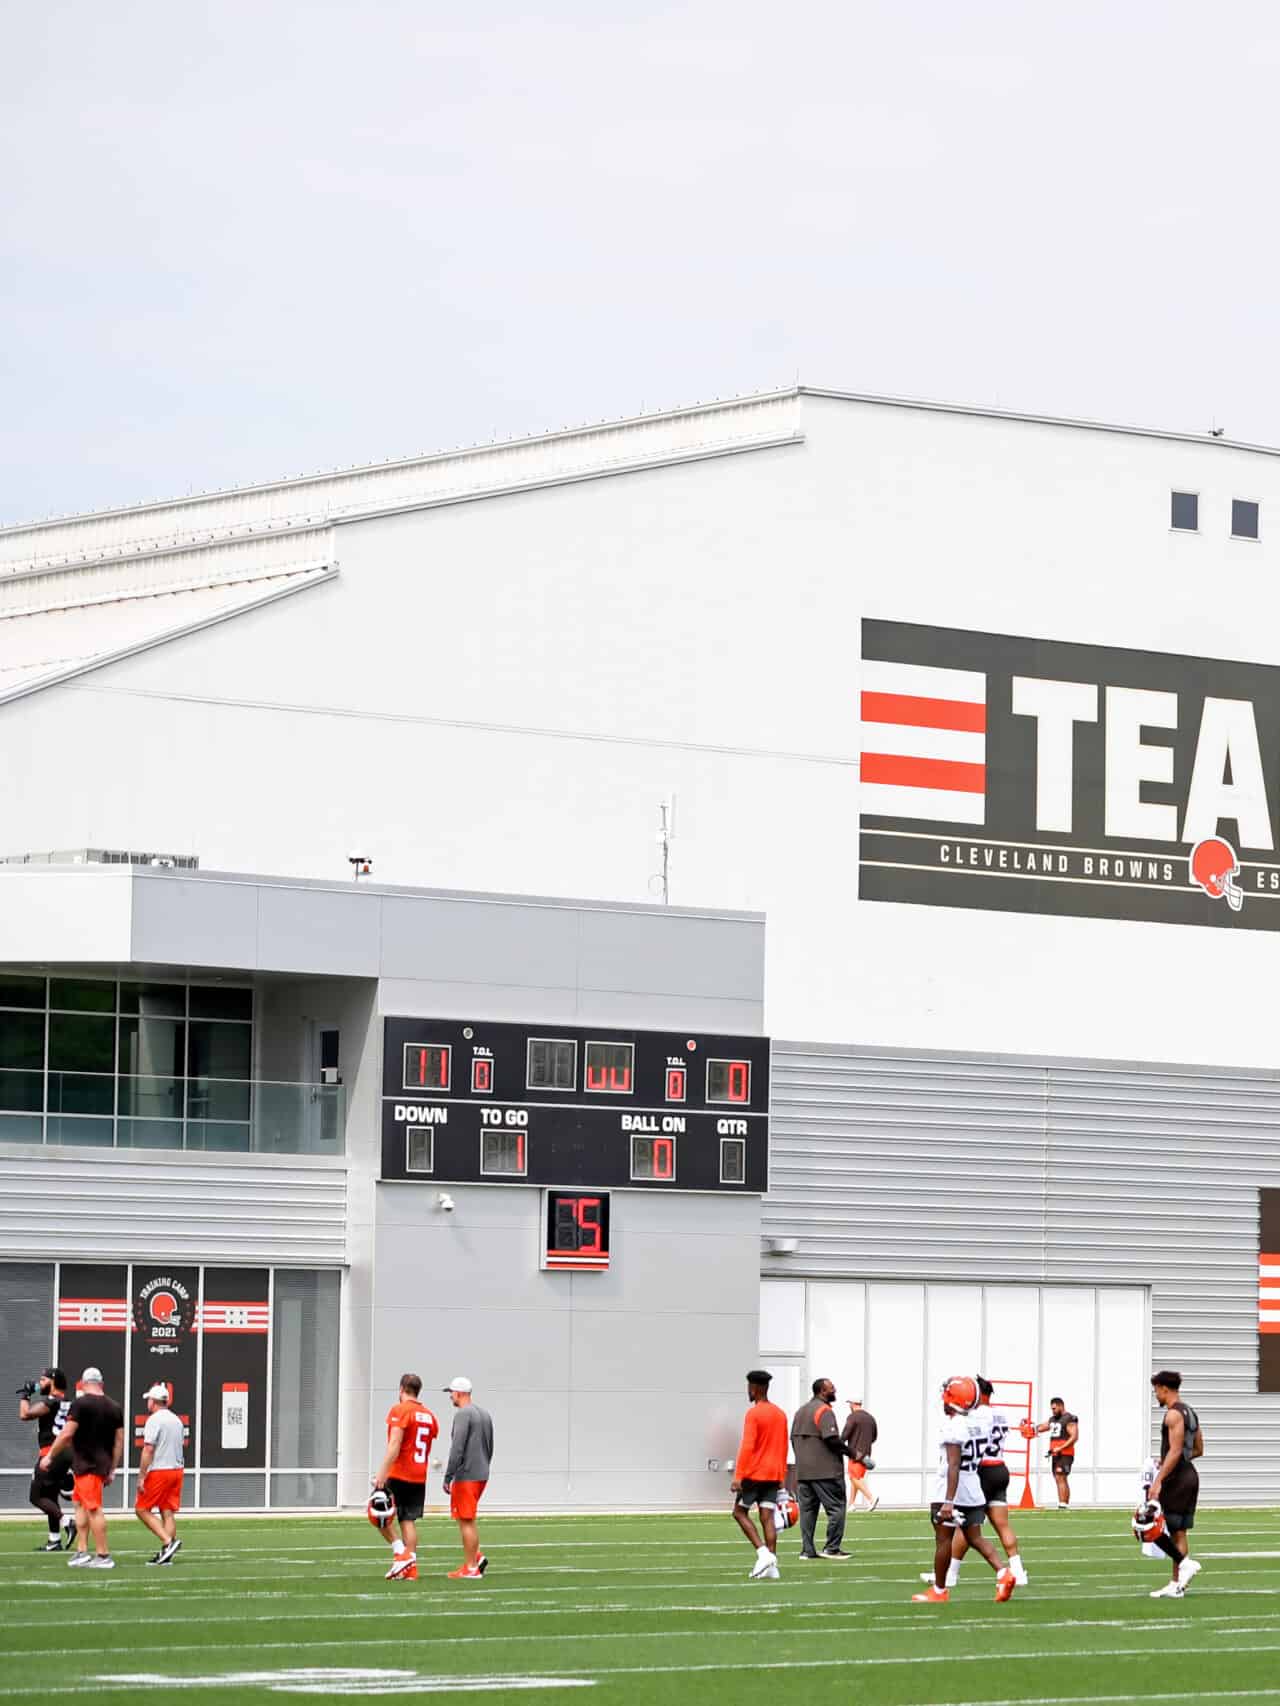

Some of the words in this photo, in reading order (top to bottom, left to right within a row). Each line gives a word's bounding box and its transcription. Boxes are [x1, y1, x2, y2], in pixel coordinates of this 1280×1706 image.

[940, 844, 1069, 873] CLEVELAND
[1084, 857, 1173, 881] BROWNS
[475, 1061, 489, 1088] 0
[668, 1071, 684, 1098] 0
[728, 1062, 748, 1102] 0
[394, 1105, 448, 1124] DOWN
[480, 1108, 501, 1124] TO
[505, 1110, 528, 1125] GO
[621, 1115, 660, 1131] BALL
[662, 1117, 686, 1132] ON
[717, 1119, 748, 1135] QTR
[653, 1138, 672, 1178] 0
[139, 1277, 172, 1300] TRAINING
[171, 1280, 190, 1300] CAMP
[151, 1327, 177, 1337] 2021
[414, 1426, 430, 1464] 5
